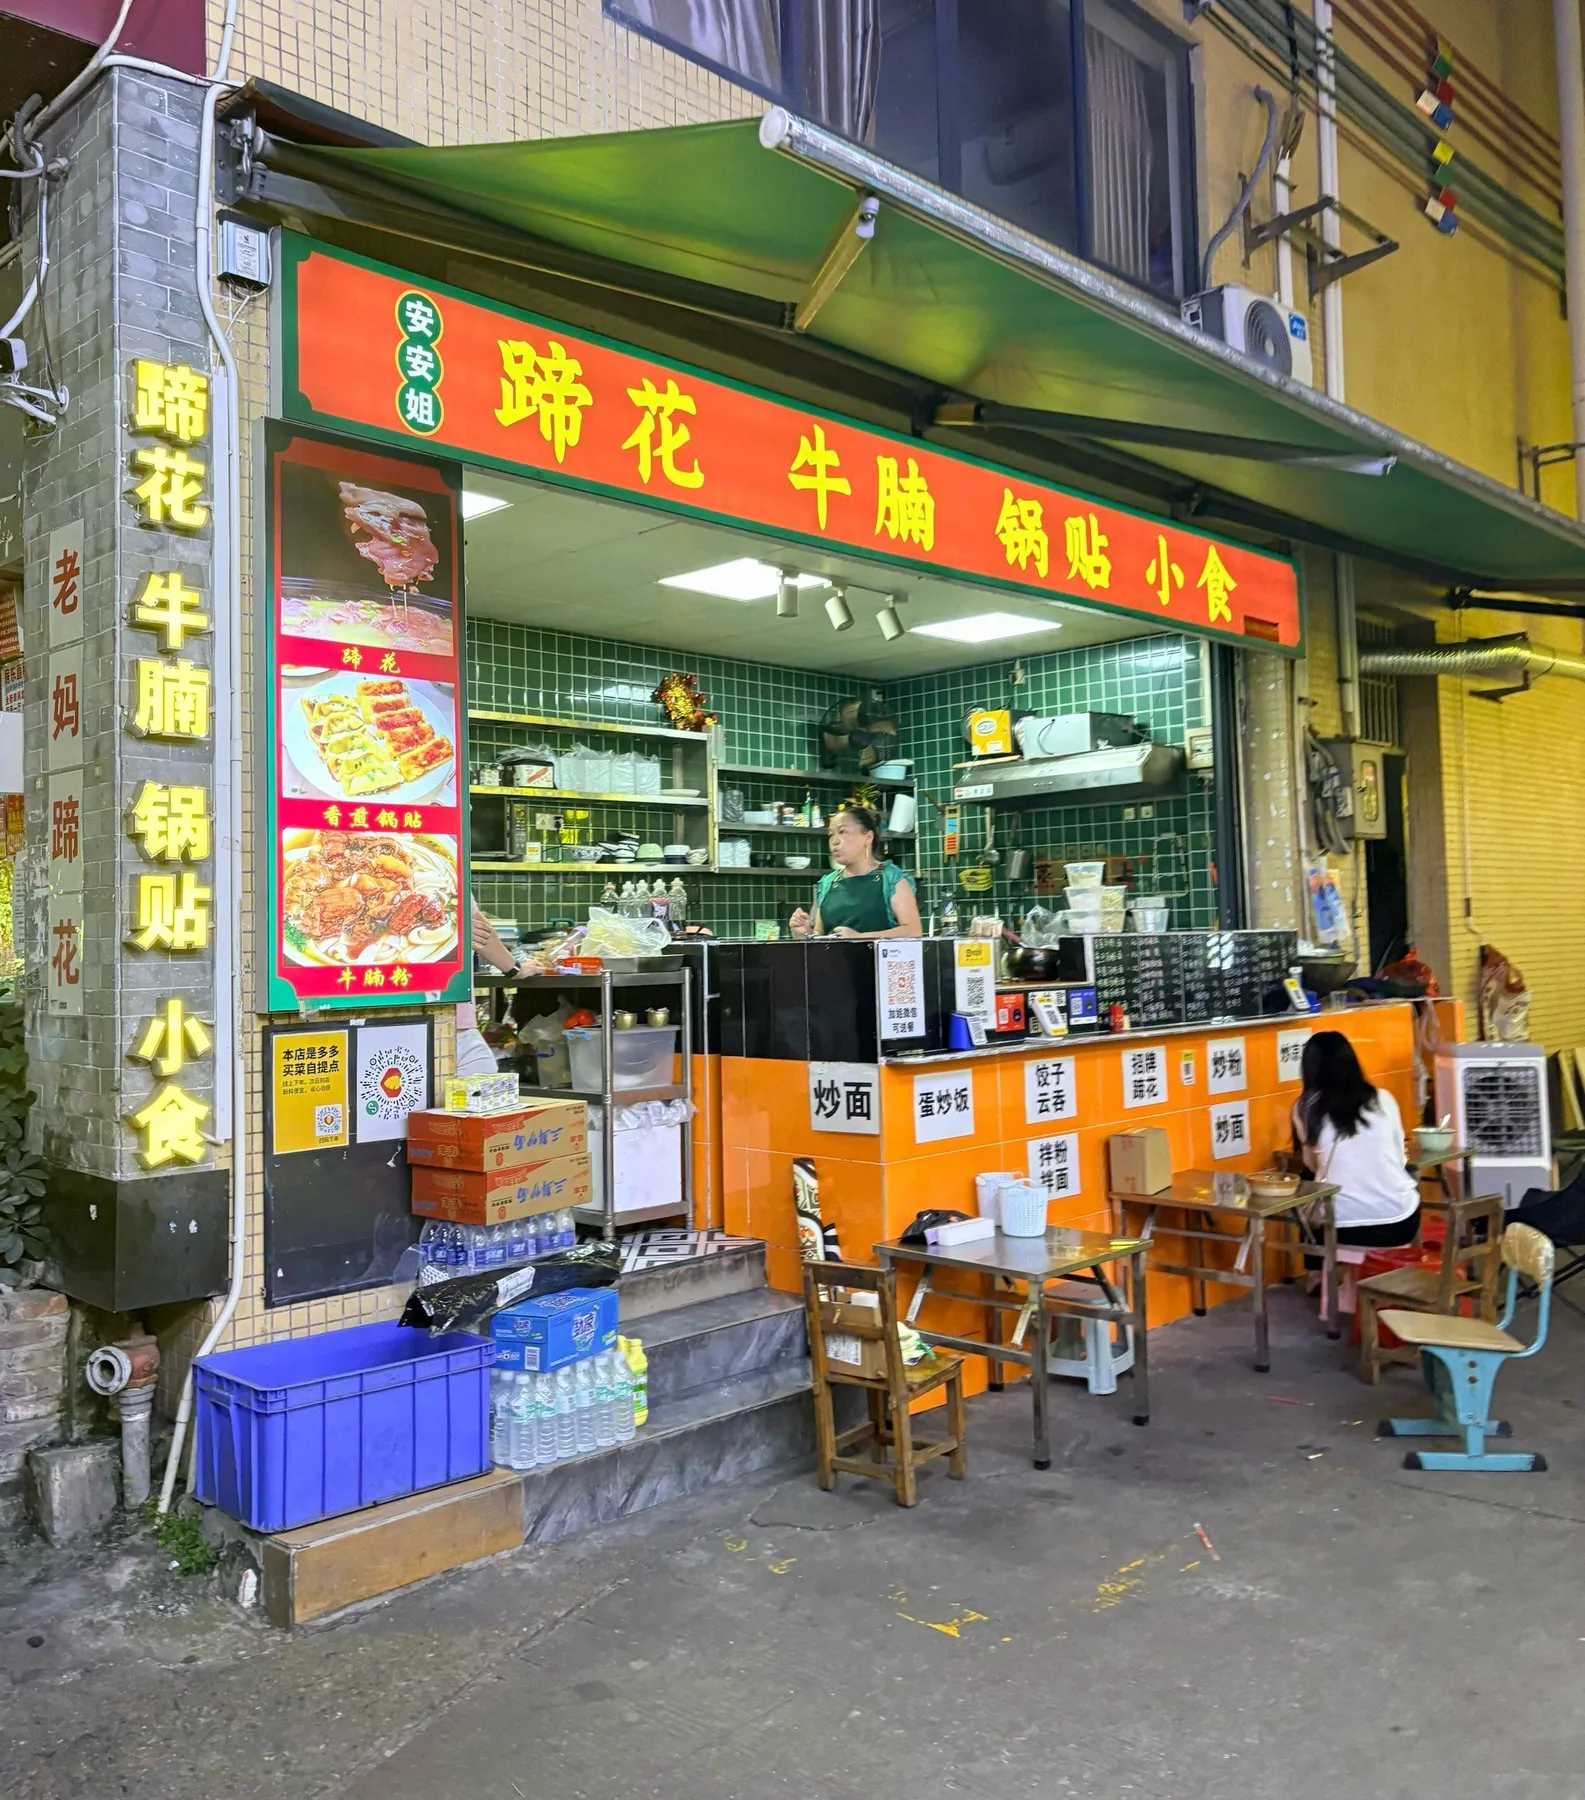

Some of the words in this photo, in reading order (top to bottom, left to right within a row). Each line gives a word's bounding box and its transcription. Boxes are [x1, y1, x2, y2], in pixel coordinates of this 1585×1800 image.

[404, 299, 436, 427] 安安姐
[135, 360, 209, 526] 蹄花
[494, 339, 705, 489] 蹄花
[788, 424, 935, 552] 牛腩
[996, 488, 1112, 590] 锅贴
[1146, 535, 1238, 622] 小食
[135, 573, 210, 738] 牛腩
[341, 647, 401, 674] 蹄花
[52, 549, 80, 987] 老妈蹄花
[322, 805, 423, 829] 香煎锅贴
[133, 779, 210, 951] 锅贴
[337, 966, 413, 991] 牛腩粉
[282, 1045, 339, 1061] 本店是多多
[1212, 1049, 1242, 1079] 炒粉
[282, 1060, 340, 1077] 买菜自提点
[1036, 1063, 1065, 1087] 饺子
[134, 1000, 211, 1168] 小食
[1133, 1076, 1158, 1101] 蹄花
[813, 1080, 872, 1120] 炒面
[919, 1087, 970, 1118] 蛋炒饭
[1037, 1089, 1066, 1114] 云吞
[1215, 1113, 1245, 1143] 炒面
[1041, 1167, 1069, 1194] 拌面
